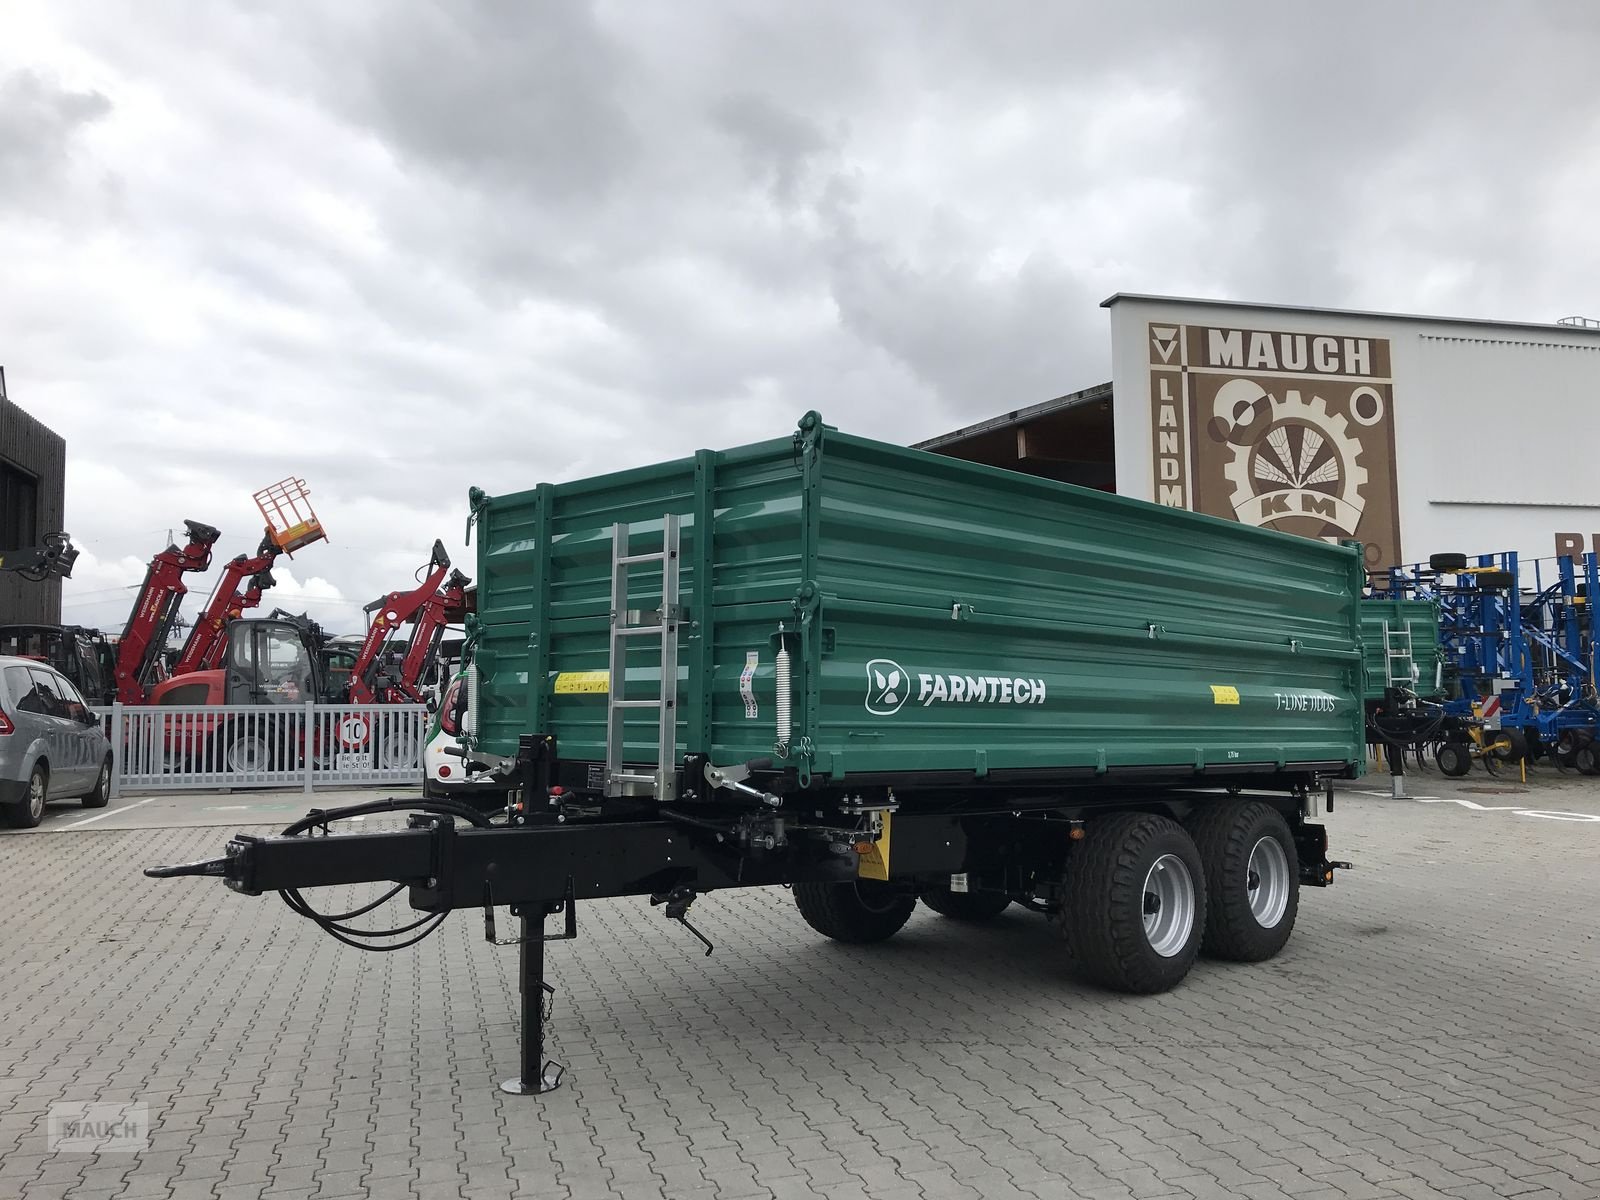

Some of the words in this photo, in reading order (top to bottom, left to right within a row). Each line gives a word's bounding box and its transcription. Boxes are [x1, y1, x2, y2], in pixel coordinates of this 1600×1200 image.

[1208, 328, 1371, 375] MAUCH
[1260, 492, 1338, 521] KM
[362, 627, 379, 660] WEIDEMANN
[917, 673, 1046, 707] FARMTECH
[1274, 692, 1308, 711] T-LINE
[1309, 695, 1335, 712] 1100S
[345, 722, 363, 739] 10
